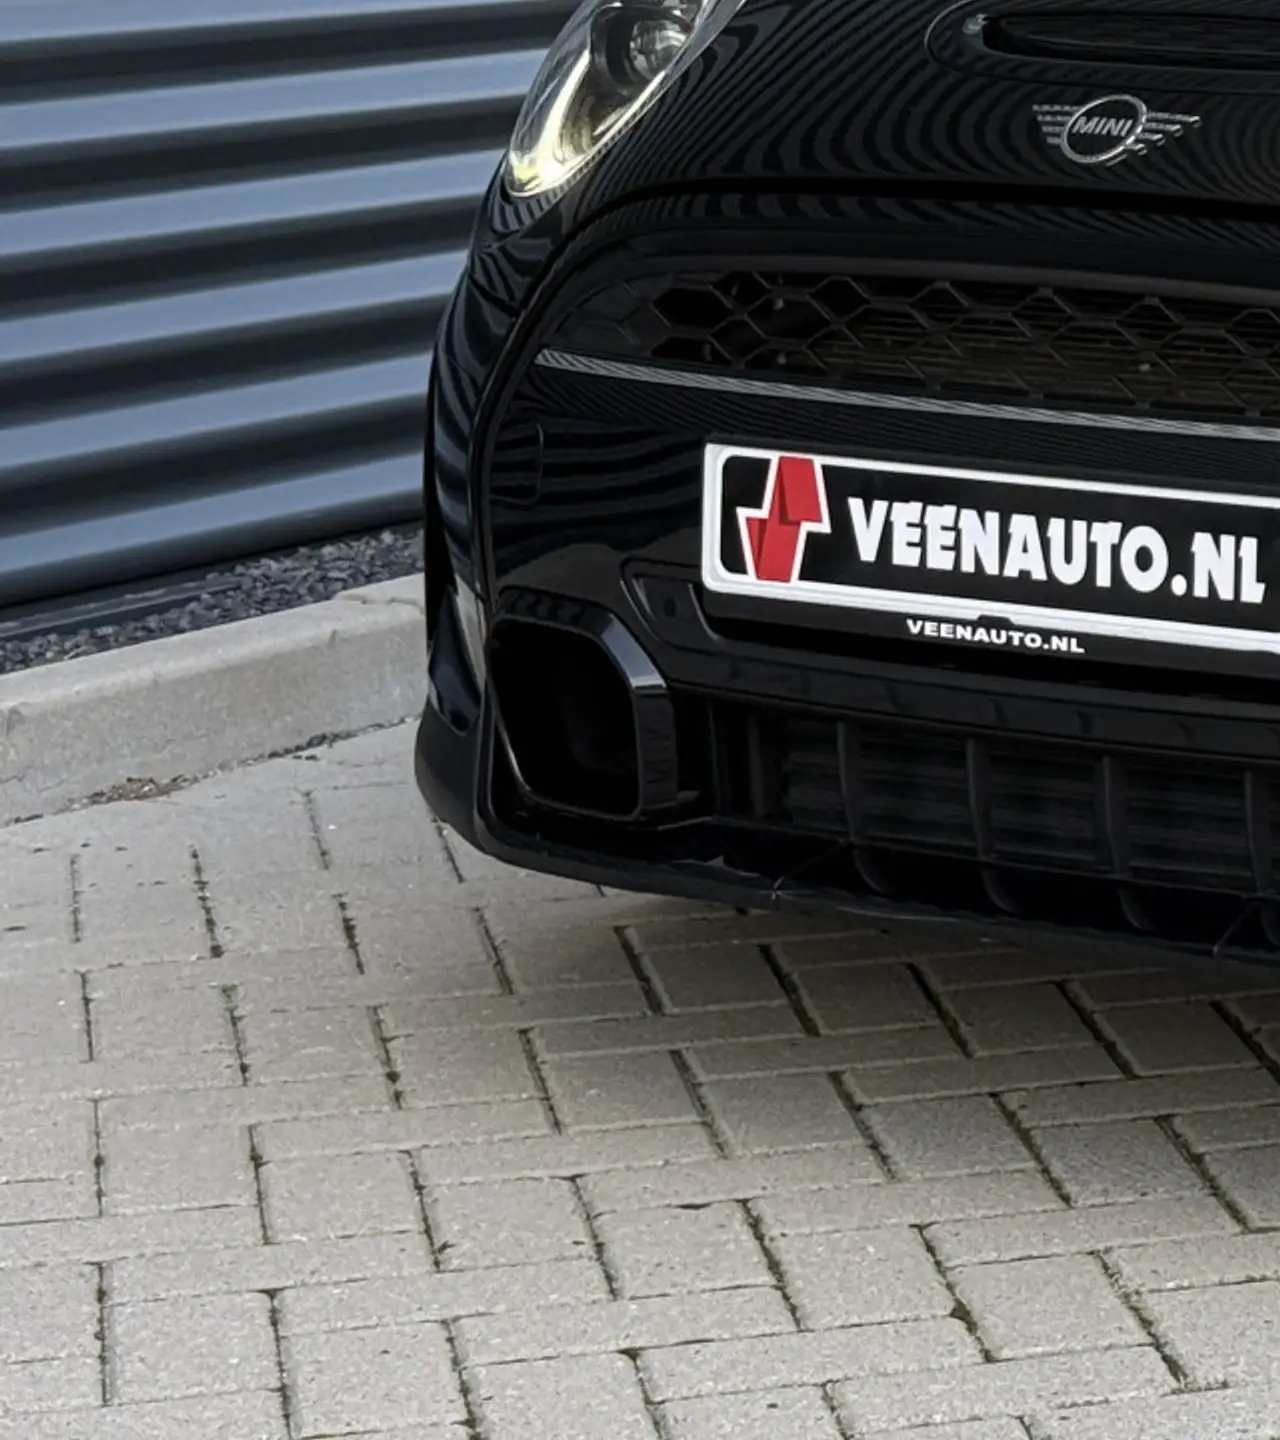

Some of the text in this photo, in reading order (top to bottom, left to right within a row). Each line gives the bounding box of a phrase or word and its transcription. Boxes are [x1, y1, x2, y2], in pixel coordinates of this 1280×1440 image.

[1071, 116, 1134, 138] MINI
[846, 496, 1266, 604] VEENAUTO.NL
[906, 618, 1086, 654] VEENAUTO.NL
